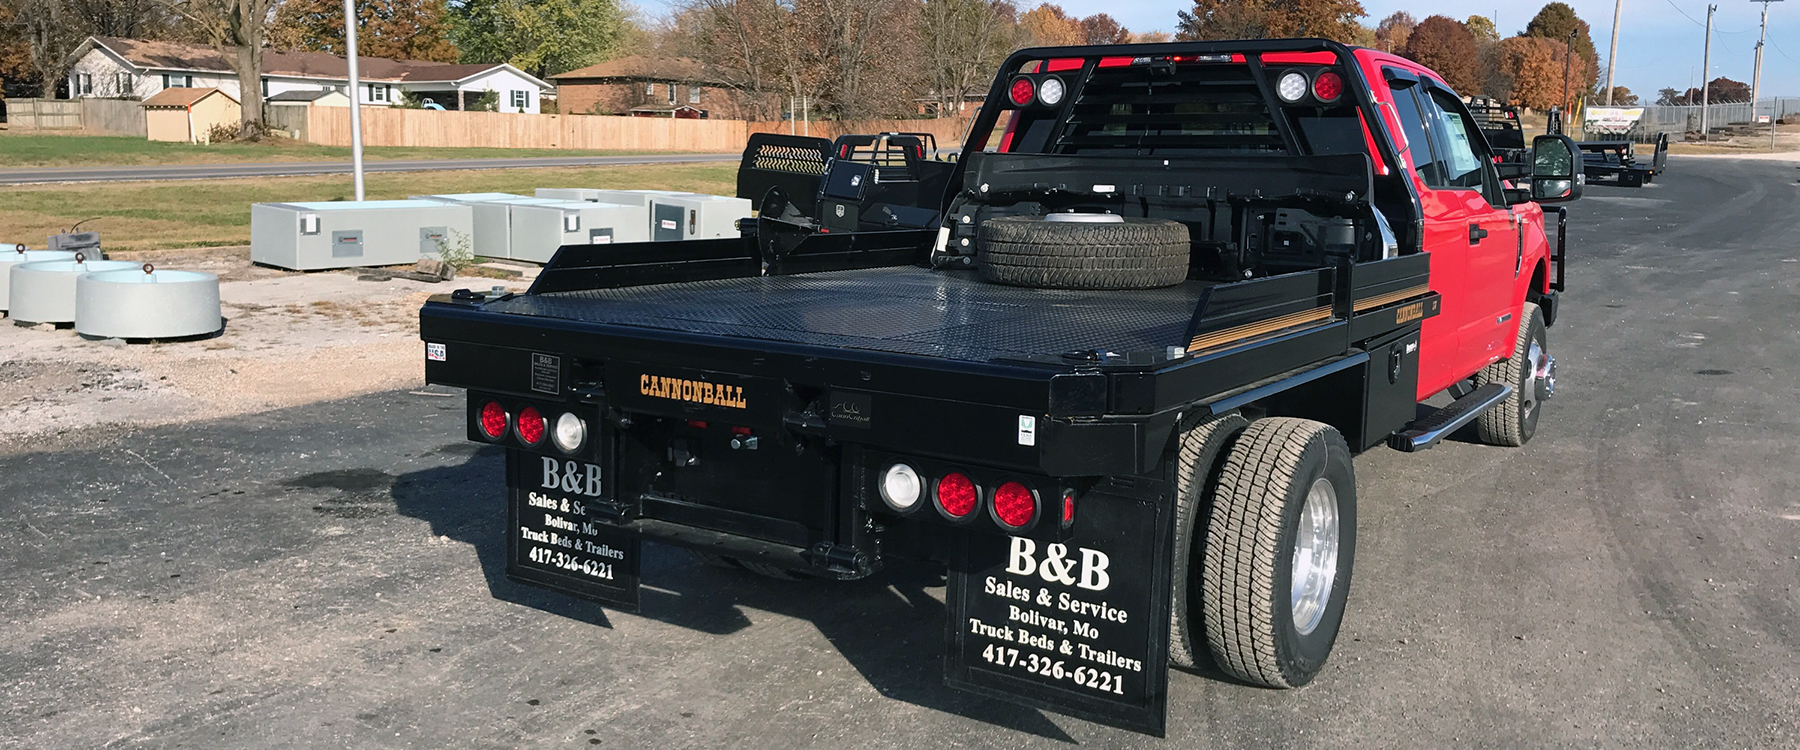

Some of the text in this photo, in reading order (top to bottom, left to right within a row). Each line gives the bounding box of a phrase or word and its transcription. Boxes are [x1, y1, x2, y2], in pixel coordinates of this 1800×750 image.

[640, 373, 747, 409] CANNONBALL
[541, 456, 602, 497] B&B
[528, 491, 558, 511] Sales
[560, 497, 571, 513] &
[544, 513, 581, 534] Bolivar,
[520, 526, 625, 560] Truck Beds & Trailers
[528, 546, 614, 580] 417-326-6221
[1005, 535, 1110, 591] B&B
[984, 576, 1128, 624] Sales & Service
[1008, 604, 1100, 640] Bolivar, Mo
[969, 617, 1142, 672] Truck Beds & Trailers
[982, 643, 1124, 695] 417-326-6221
